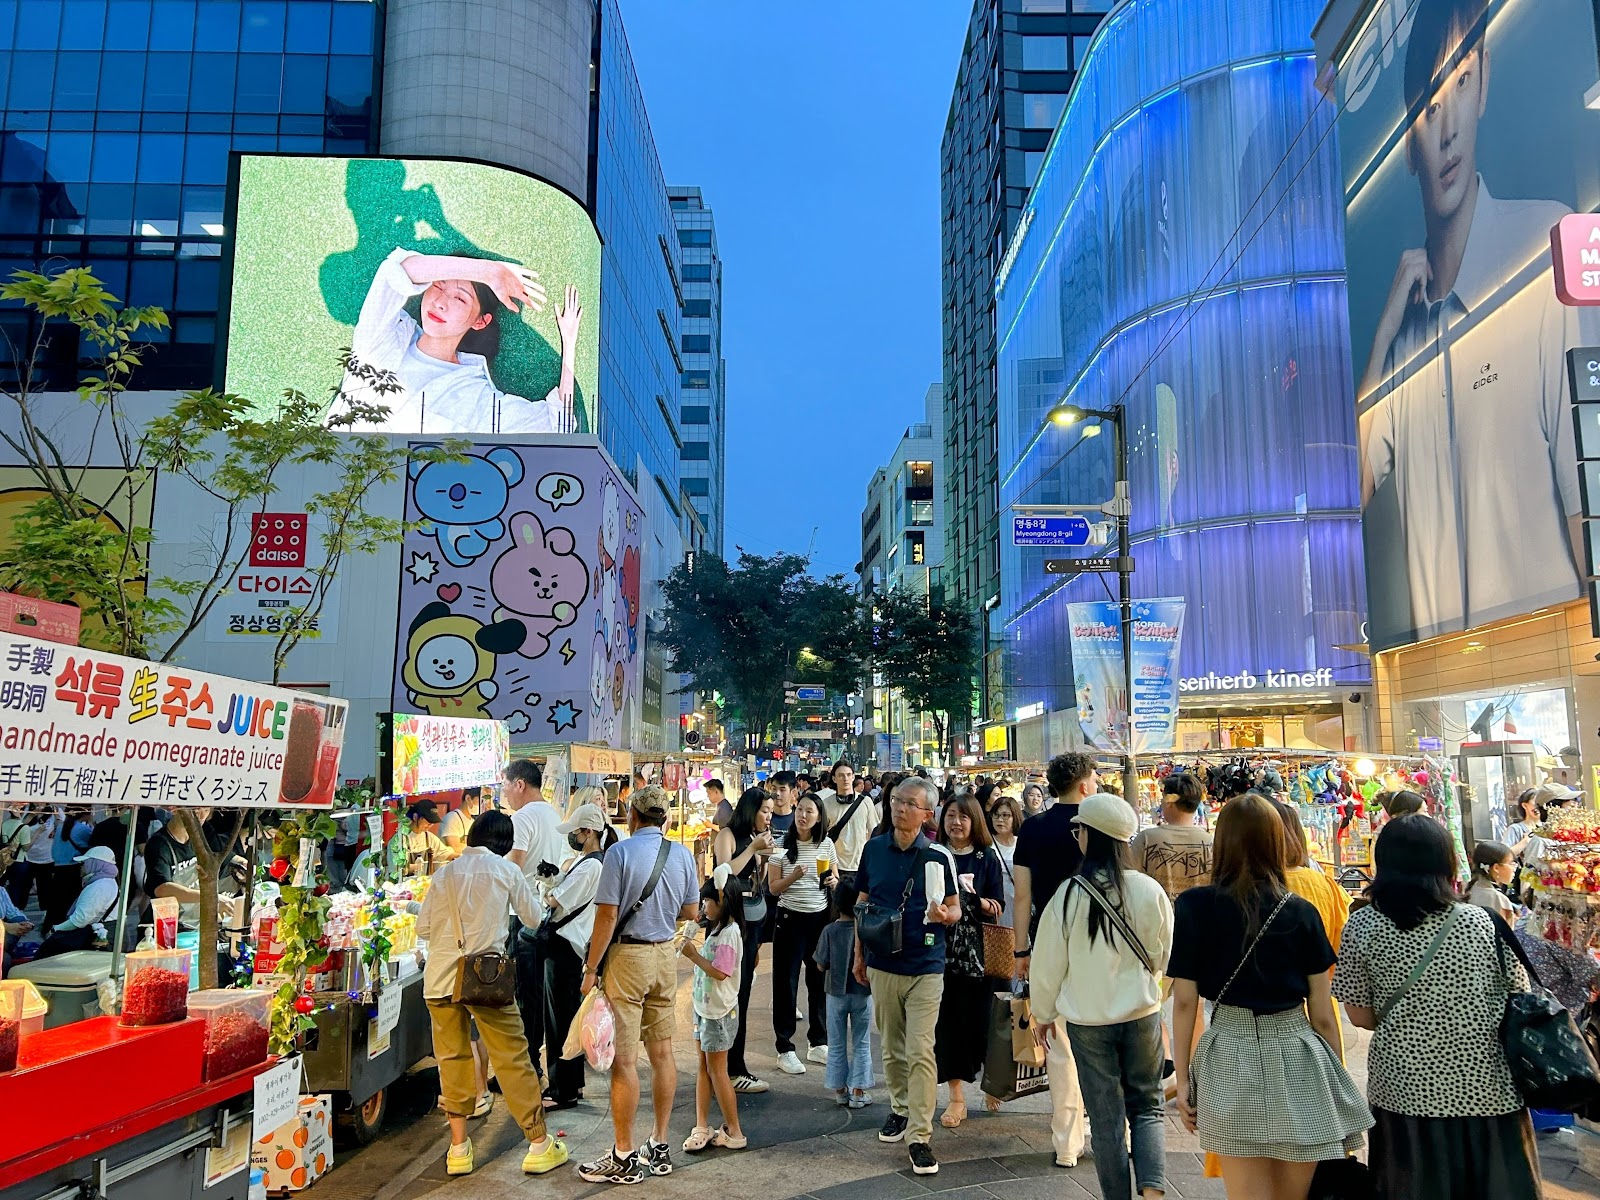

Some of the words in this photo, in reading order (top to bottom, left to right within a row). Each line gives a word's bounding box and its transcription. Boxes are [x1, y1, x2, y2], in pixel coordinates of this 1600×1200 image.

[1473, 373, 1499, 390] EIDER
[1016, 519, 1047, 529] 명동8길
[1016, 530, 1057, 538] Myeongdong
[1058, 530, 1073, 538] 8-gil
[256, 548, 299, 561] daiso
[238, 576, 312, 593] 다이소
[7, 643, 54, 676] 手製
[1179, 669, 1257, 692] senherb
[1267, 667, 1333, 688] kineff
[217, 693, 289, 740] JUICE
[0, 721, 117, 759] andmade
[123, 737, 245, 769] pomegranate
[247, 746, 283, 772] juice
[1018, 1081, 1031, 1090] Foot
[1031, 1077, 1048, 1087] Locke
[309, 1138, 326, 1154] ORANGES
